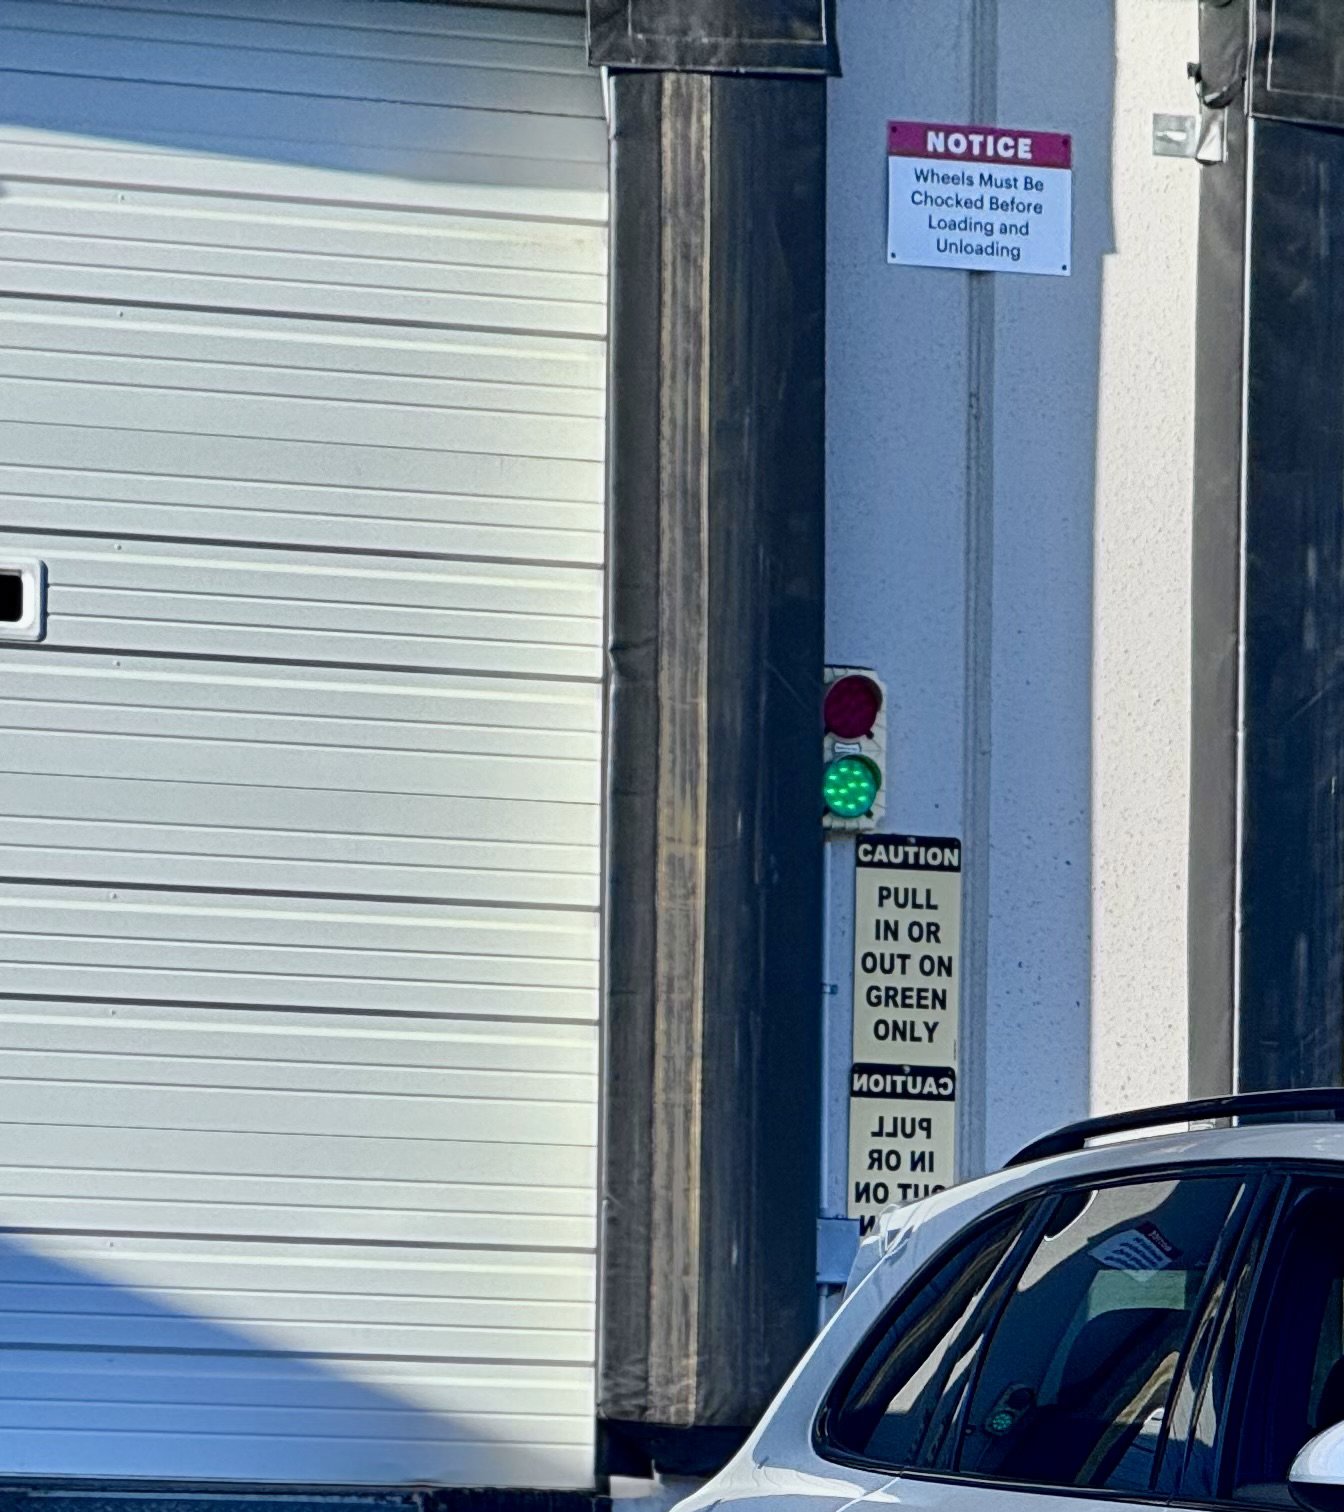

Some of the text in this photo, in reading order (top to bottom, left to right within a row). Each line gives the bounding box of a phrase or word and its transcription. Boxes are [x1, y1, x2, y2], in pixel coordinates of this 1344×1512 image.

[926, 130, 1033, 160] NOTICE
[914, 168, 1045, 193] Wheels Must Be
[910, 191, 1043, 215] Chocked Before
[928, 215, 1030, 237] Loading and
[936, 238, 1022, 262] Unloading
[857, 844, 959, 867] CAUTION
[877, 886, 939, 911] PULL
[875, 919, 942, 944] IN OR
[861, 951, 953, 978] OUT ON
[865, 985, 947, 1011] GREEN
[873, 1018, 940, 1044] ONLY
